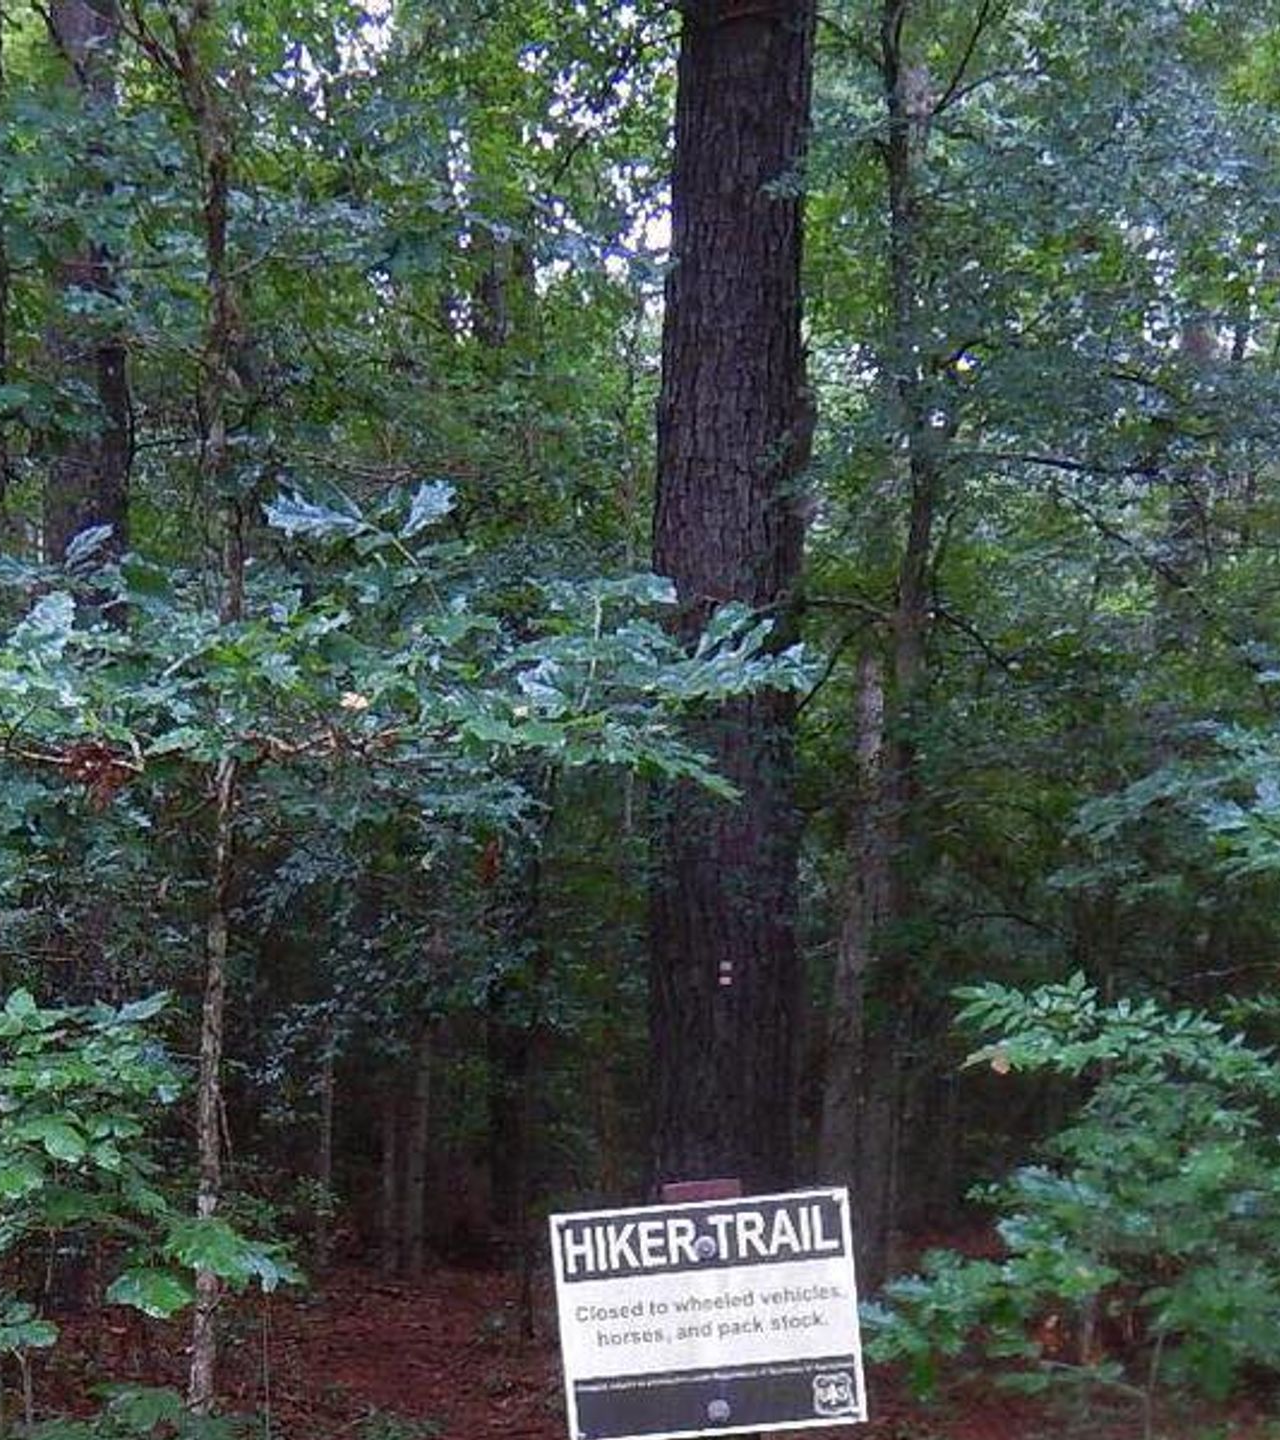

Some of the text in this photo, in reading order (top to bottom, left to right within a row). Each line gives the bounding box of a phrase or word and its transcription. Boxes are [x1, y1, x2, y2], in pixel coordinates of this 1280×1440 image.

[564, 1205, 840, 1274] HIKER TRAIL
[575, 1301, 644, 1322] Closed
[649, 1301, 669, 1316] to
[675, 1291, 754, 1313] wheeled
[676, 1322, 713, 1340] and
[718, 1316, 764, 1340] pack
